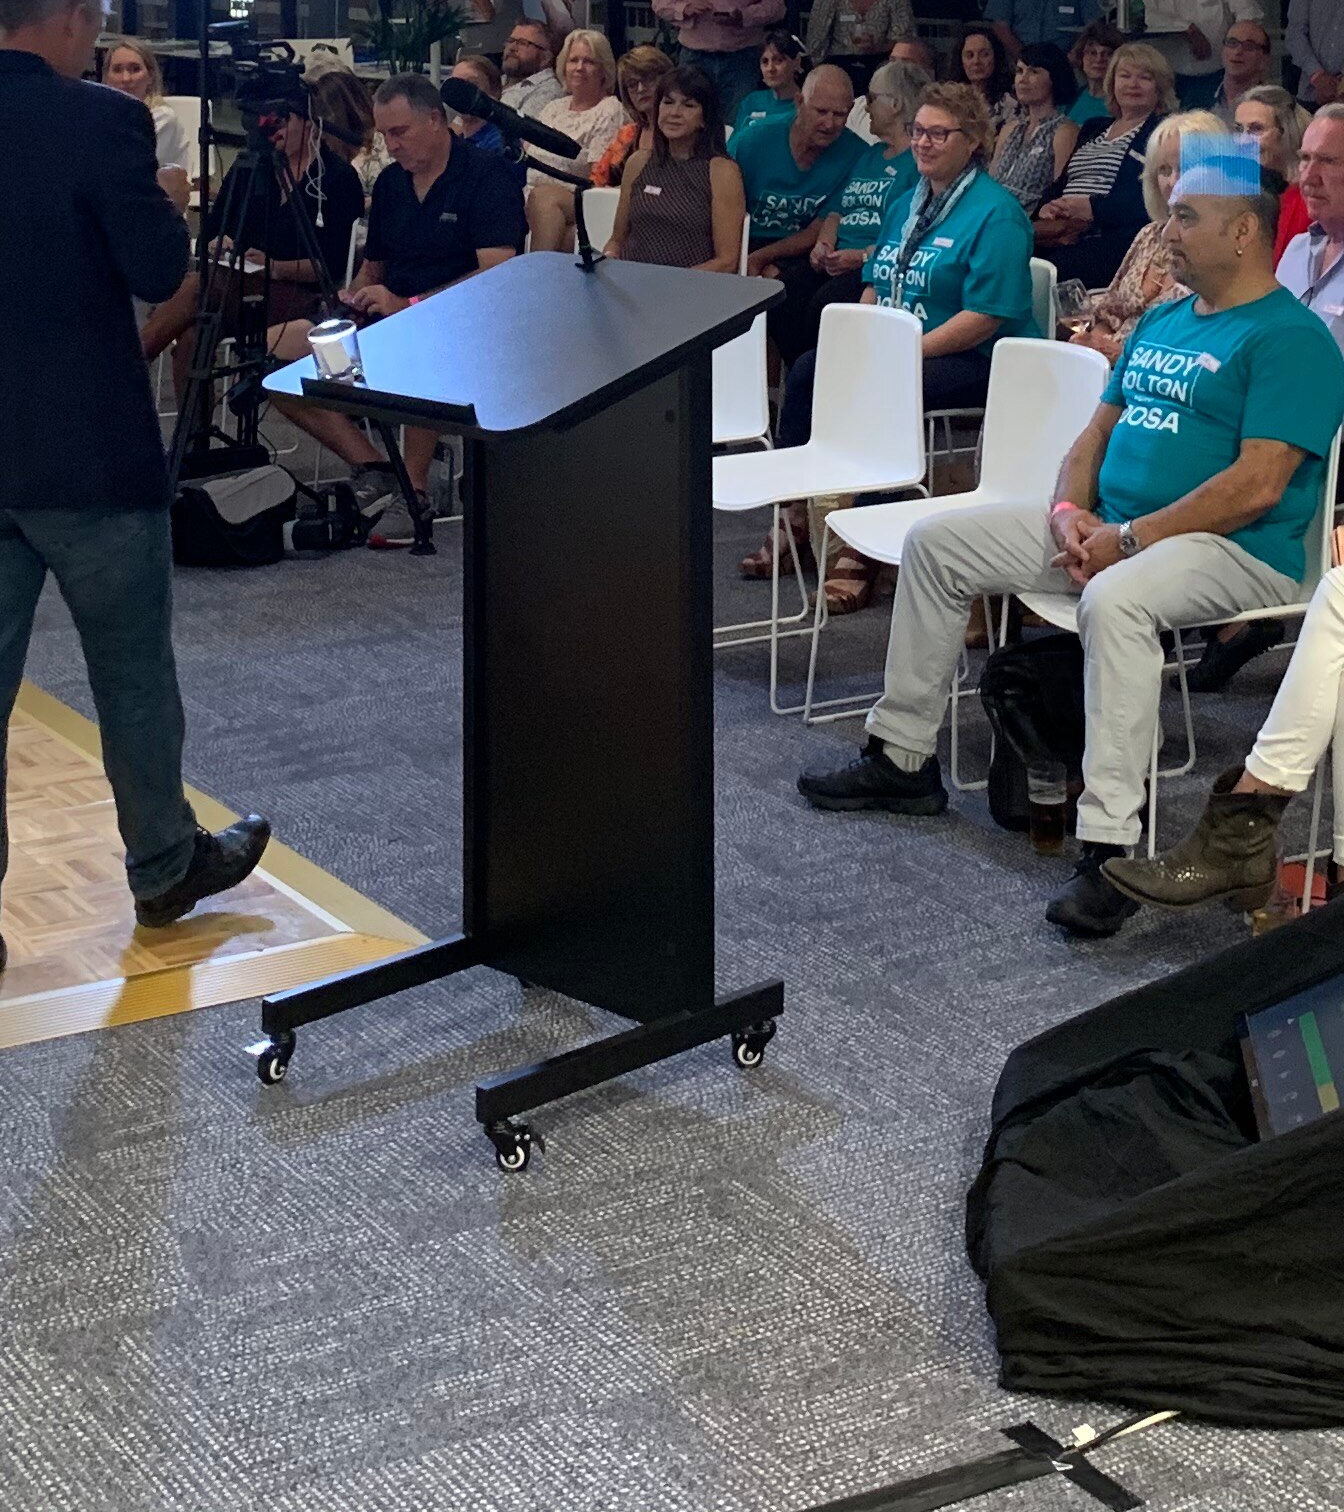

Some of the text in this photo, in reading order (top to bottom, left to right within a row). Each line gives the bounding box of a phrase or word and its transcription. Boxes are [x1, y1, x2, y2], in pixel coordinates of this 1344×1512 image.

[844, 181, 891, 194] SANDY
[877, 245, 935, 267] SADY
[1129, 347, 1199, 376] SANDY
[1123, 370, 1188, 402] OLTON
